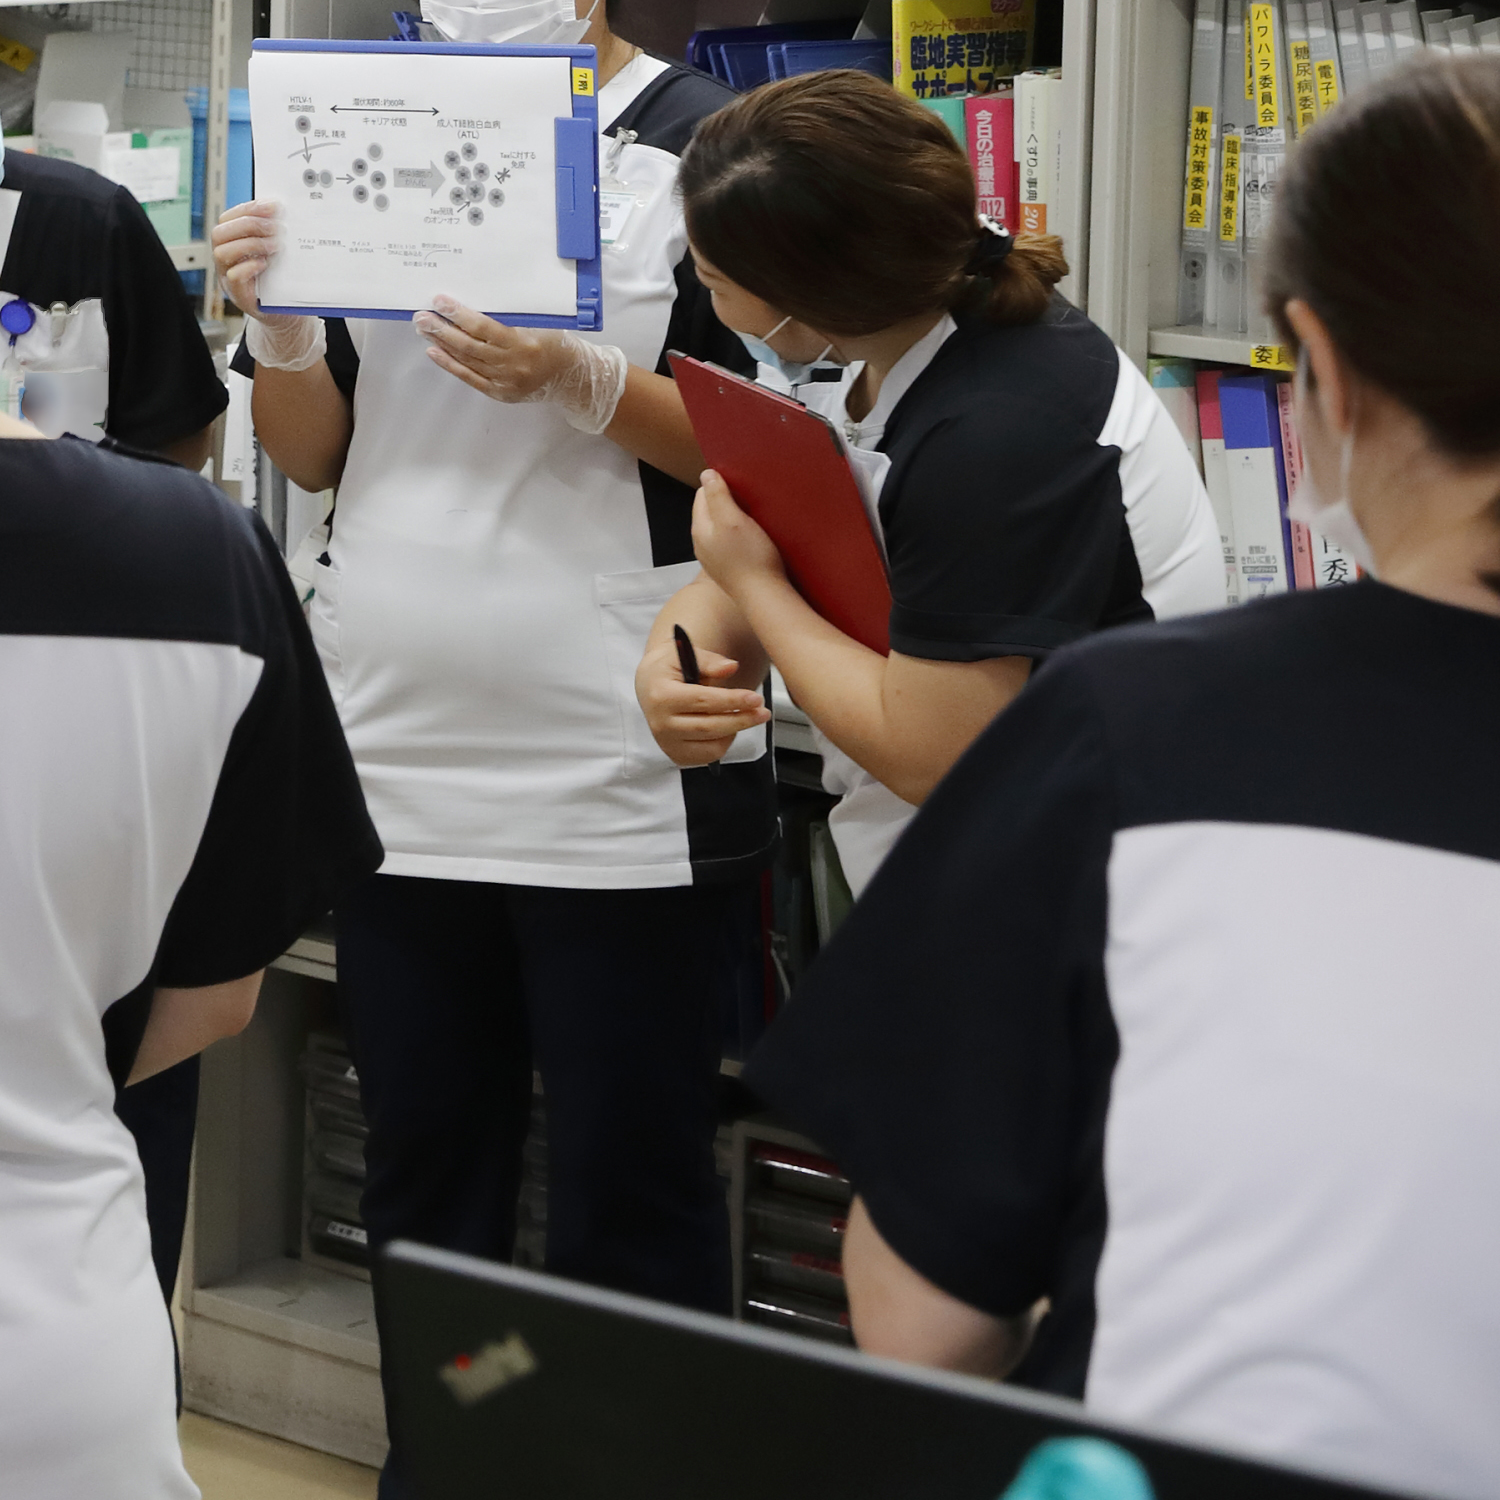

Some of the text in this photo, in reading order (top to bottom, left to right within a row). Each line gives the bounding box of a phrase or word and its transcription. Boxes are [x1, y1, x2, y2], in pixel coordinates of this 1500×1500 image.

[456, 130, 480, 140] (ATL)
[975, 109, 995, 197] 今日の治療薬
[1188, 110, 1209, 224] 事故対策委員会
[1221, 140, 1239, 237] 臨床指導者会
